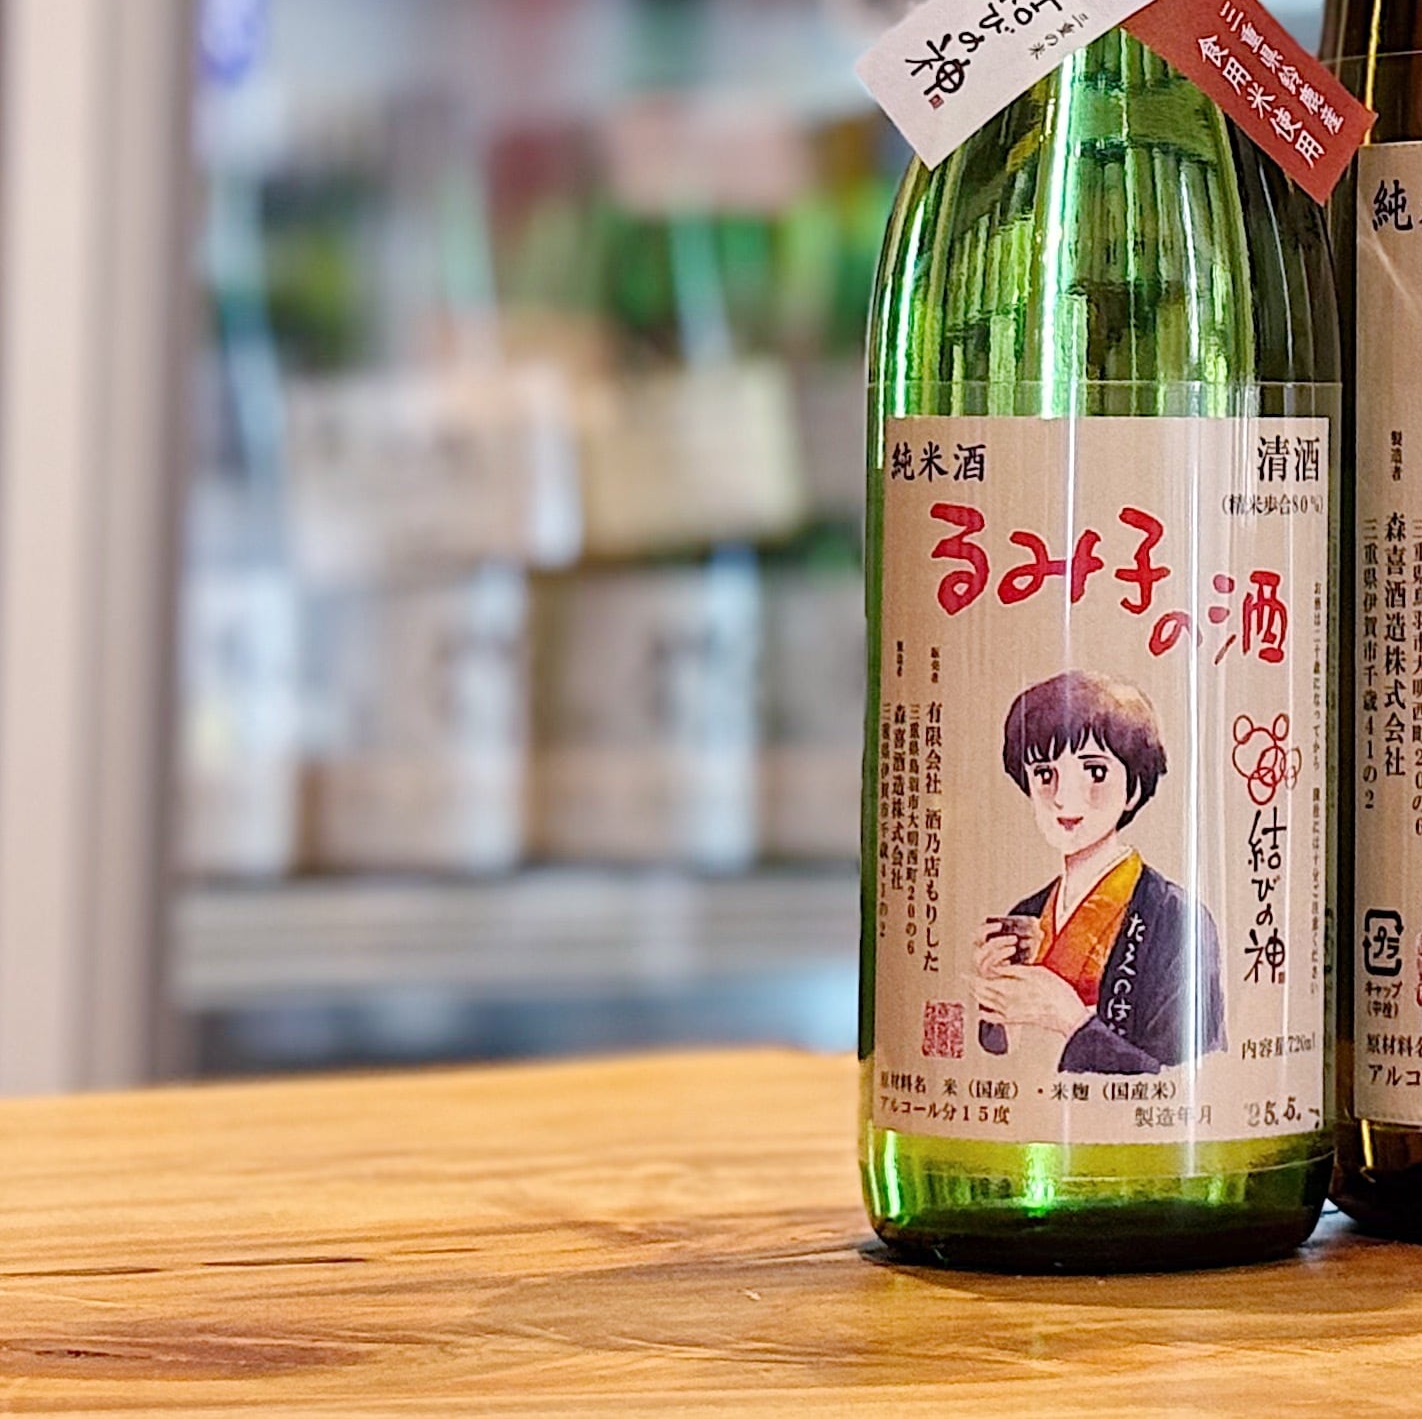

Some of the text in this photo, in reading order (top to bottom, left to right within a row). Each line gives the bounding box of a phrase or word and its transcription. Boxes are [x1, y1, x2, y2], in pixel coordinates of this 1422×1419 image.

[1028, 12, 1089, 61] 三重の米
[1219, 0, 1344, 135] 三重県鈴鹿産
[1198, 35, 1326, 169] 食用米使用
[891, 442, 987, 483] 純米酒
[1257, 434, 1321, 482] 清酒
[1384, 511, 1407, 778] 森喜酒造株式会社
[1243, 809, 1289, 986] 結びの神
[1364, 980, 1403, 999] キャップ
[879, 1096, 1011, 1126] アルコール分15度
